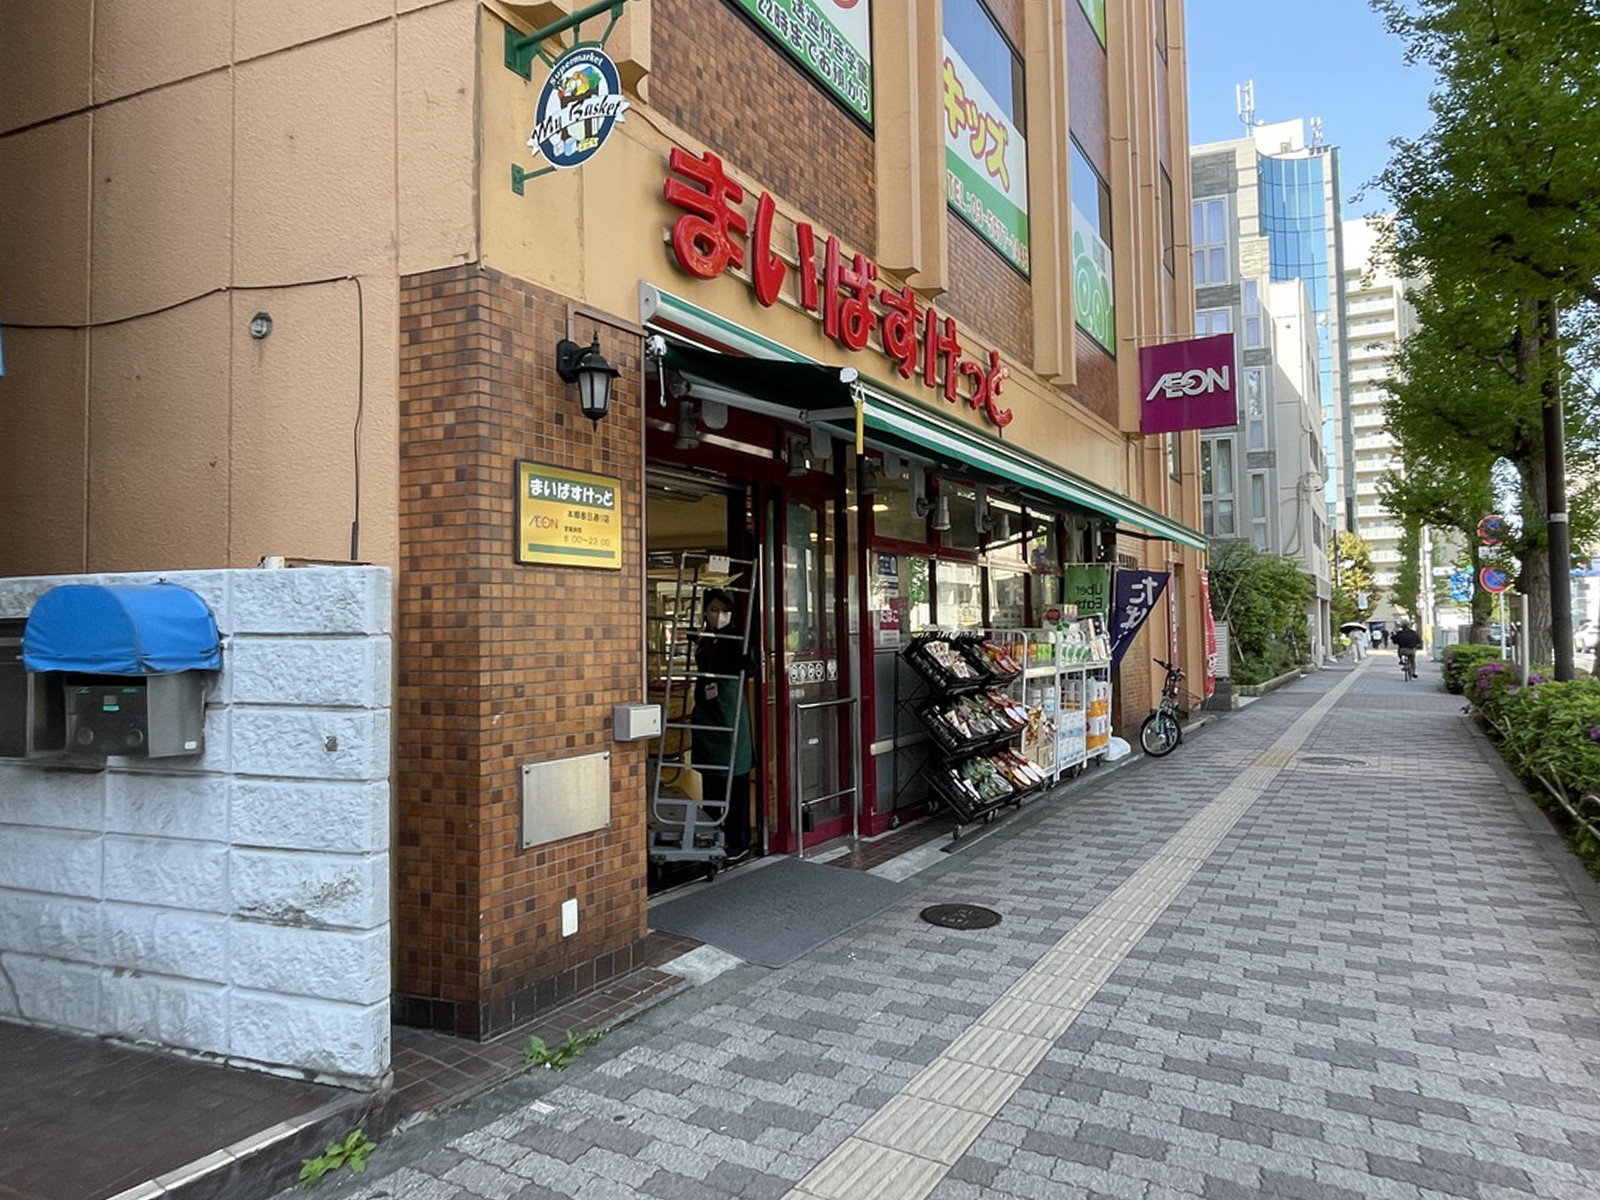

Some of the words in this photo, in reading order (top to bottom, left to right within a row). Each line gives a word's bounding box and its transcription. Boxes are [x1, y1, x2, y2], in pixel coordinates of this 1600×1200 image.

[532, 115, 563, 143] My
[568, 95, 621, 122] Basket
[943, 56, 1010, 193] キッズ
[664, 146, 1014, 428] まいばすけっと
[1145, 365, 1230, 402] AEON
[529, 478, 614, 507] まいばすけっと
